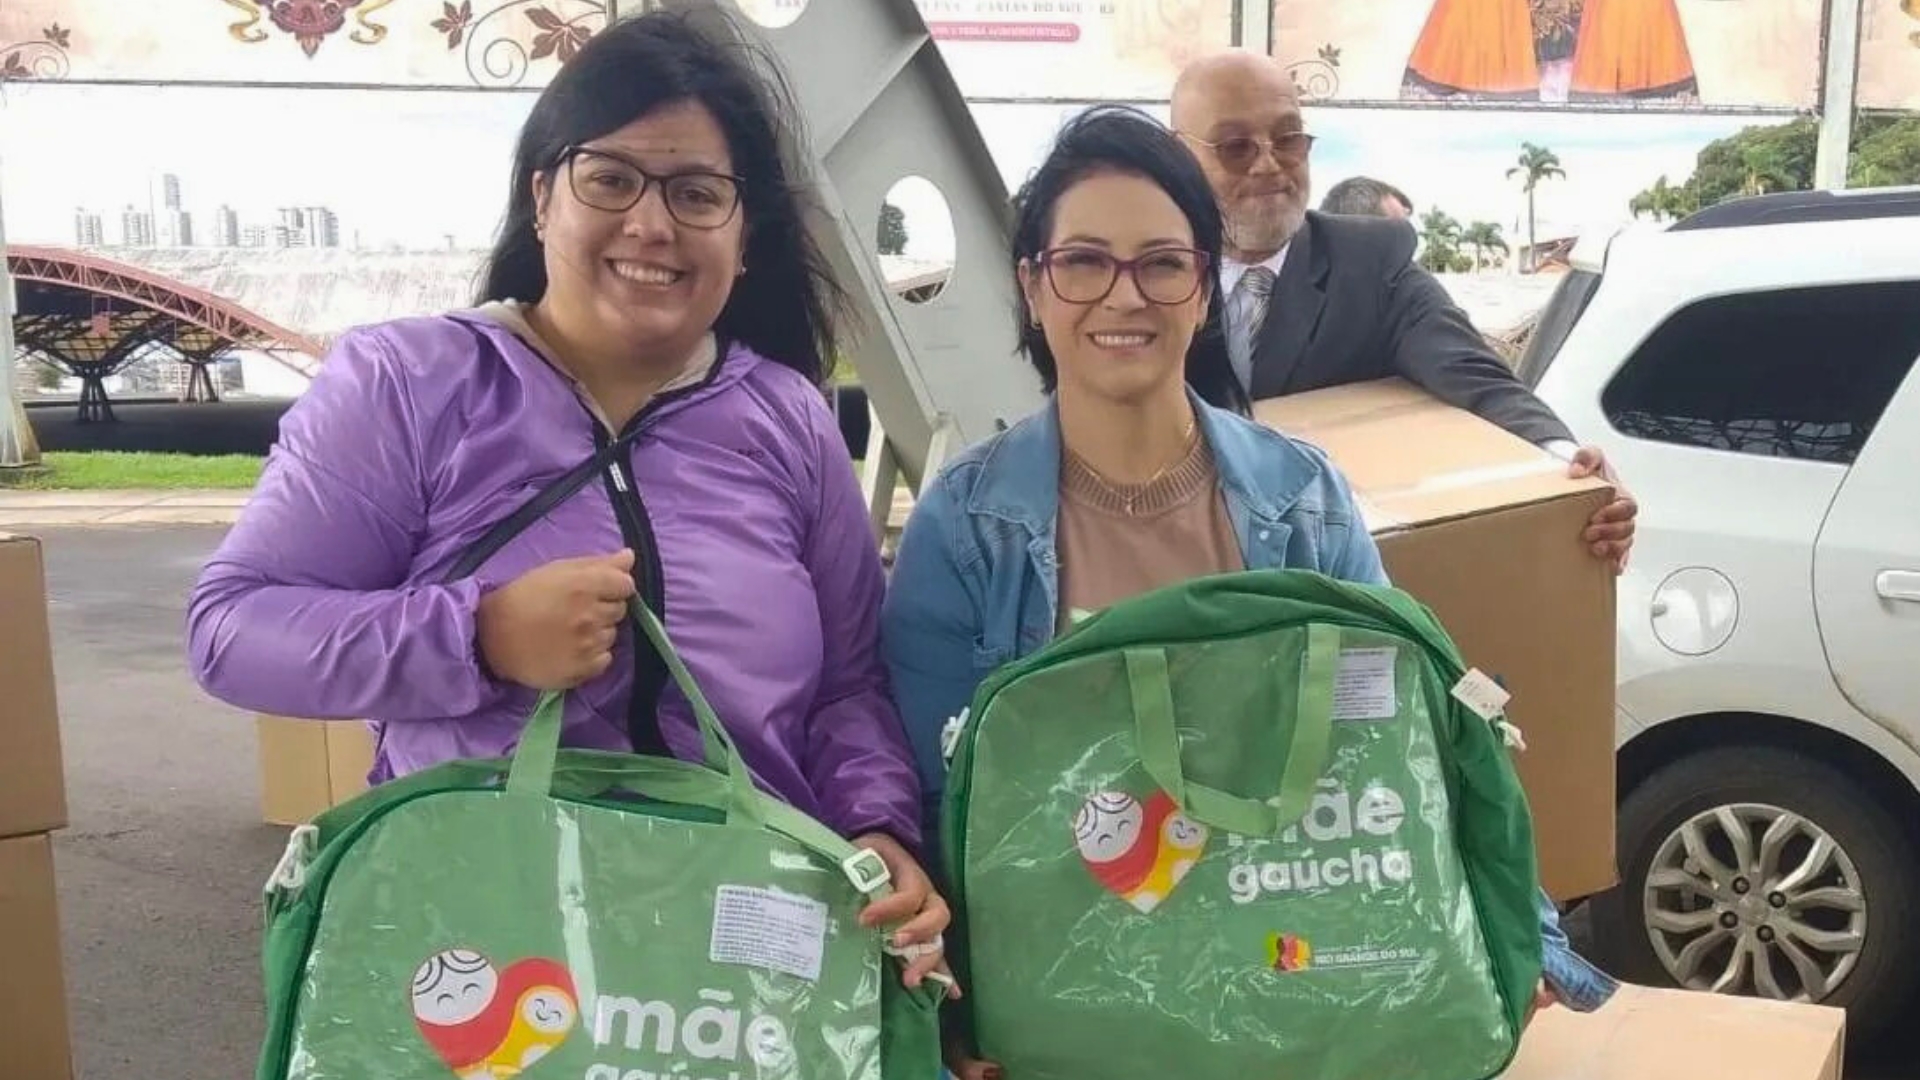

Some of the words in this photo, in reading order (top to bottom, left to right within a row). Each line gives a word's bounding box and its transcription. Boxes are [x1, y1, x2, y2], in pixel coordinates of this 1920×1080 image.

[1228, 777, 1405, 842] ãe
[1228, 847, 1413, 903] gaúcha
[1399, 947, 1420, 958] SUL
[594, 988, 788, 1068] mãe
